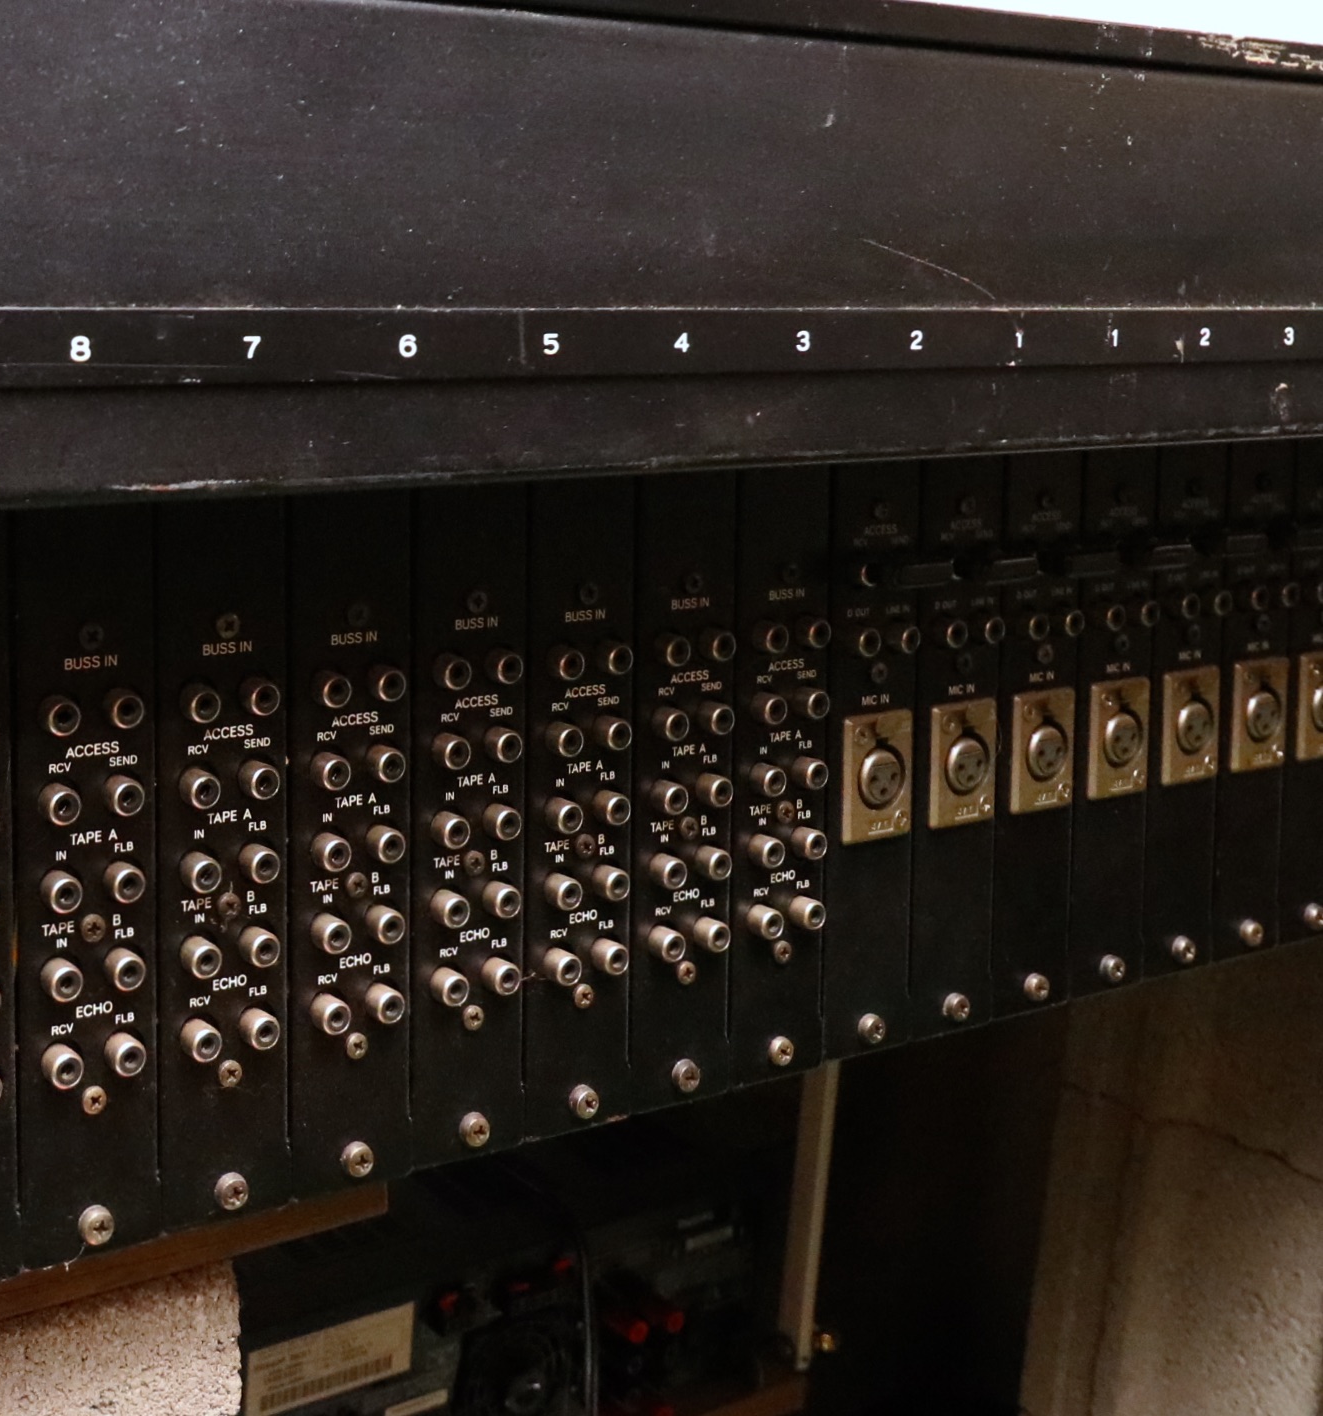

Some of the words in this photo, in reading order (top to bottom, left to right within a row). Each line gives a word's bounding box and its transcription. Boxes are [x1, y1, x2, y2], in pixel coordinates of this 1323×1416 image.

[542, 333, 559, 355] 5
[673, 332, 689, 352] 4
[796, 330, 811, 352] 3
[910, 330, 923, 350] 2
[1016, 332, 1024, 349] 1
[1111, 328, 1119, 347] 1
[1200, 328, 1210, 346] 2
[1284, 327, 1295, 346] 3
[70, 336, 92, 361] 8
[243, 336, 261, 359] 7
[398, 334, 417, 358] 6
[331, 633, 362, 646] BUSS
[366, 631, 377, 642] IN
[202, 642, 236, 656] BUSS
[239, 640, 253, 652] IN
[64, 657, 100, 671] BUSS
[105, 655, 118, 667] IN
[768, 659, 804, 672] ACCESS
[670, 670, 709, 684] ACCESS
[1029, 672, 1044, 682] MIC
[1046, 670, 1055, 680] IN
[565, 684, 606, 698] ACCESS
[948, 686, 965, 696] MIC
[967, 684, 975, 693] IN
[455, 694, 498, 709] ACCESS
[861, 695, 878, 706] MIC
[880, 694, 889, 704] IN
[331, 711, 379, 727] ACCESS
[203, 724, 254, 741] ACCESS
[770, 732, 791, 743] TAPE
[795, 730, 802, 739] A
[65, 741, 120, 759] ACCESS
[187, 744, 209, 756] RCV
[244, 737, 271, 749] SEND
[672, 745, 695, 757] TAPE
[699, 743, 706, 753] A
[48, 762, 72, 774] RCV
[109, 754, 138, 767] SEND
[567, 762, 591, 774] TAPE
[596, 760, 603, 770] A
[457, 774, 483, 788] TAPE
[488, 773, 495, 783] A
[335, 795, 363, 809] TAPE
[368, 793, 376, 803] A
[207, 810, 237, 825] TAPE
[243, 808, 252, 820] A
[248, 820, 267, 832] FLB
[69, 830, 103, 846] TAPE
[108, 828, 118, 841] A
[194, 830, 205, 840] IN
[114, 841, 134, 854] FLB
[55, 850, 67, 861] IN
[771, 870, 795, 884] ECHO
[181, 897, 212, 912] TAPE
[247, 890, 255, 902] B
[673, 888, 700, 902] ECHO
[249, 903, 267, 915] FLB
[569, 909, 597, 924] ECHO
[41, 921, 75, 937] TAPE
[112, 914, 121, 926] B
[194, 913, 205, 924] IN
[114, 927, 134, 939] FLB
[460, 927, 490, 943] ECHO
[56, 938, 68, 949] IN
[339, 953, 372, 969] ECHO
[212, 974, 247, 992] ECHO
[249, 985, 267, 997] FLB
[189, 995, 211, 1008] RCV
[76, 1001, 113, 1019] ECHO
[115, 1012, 135, 1024] FLB
[51, 1023, 74, 1036] RCV
